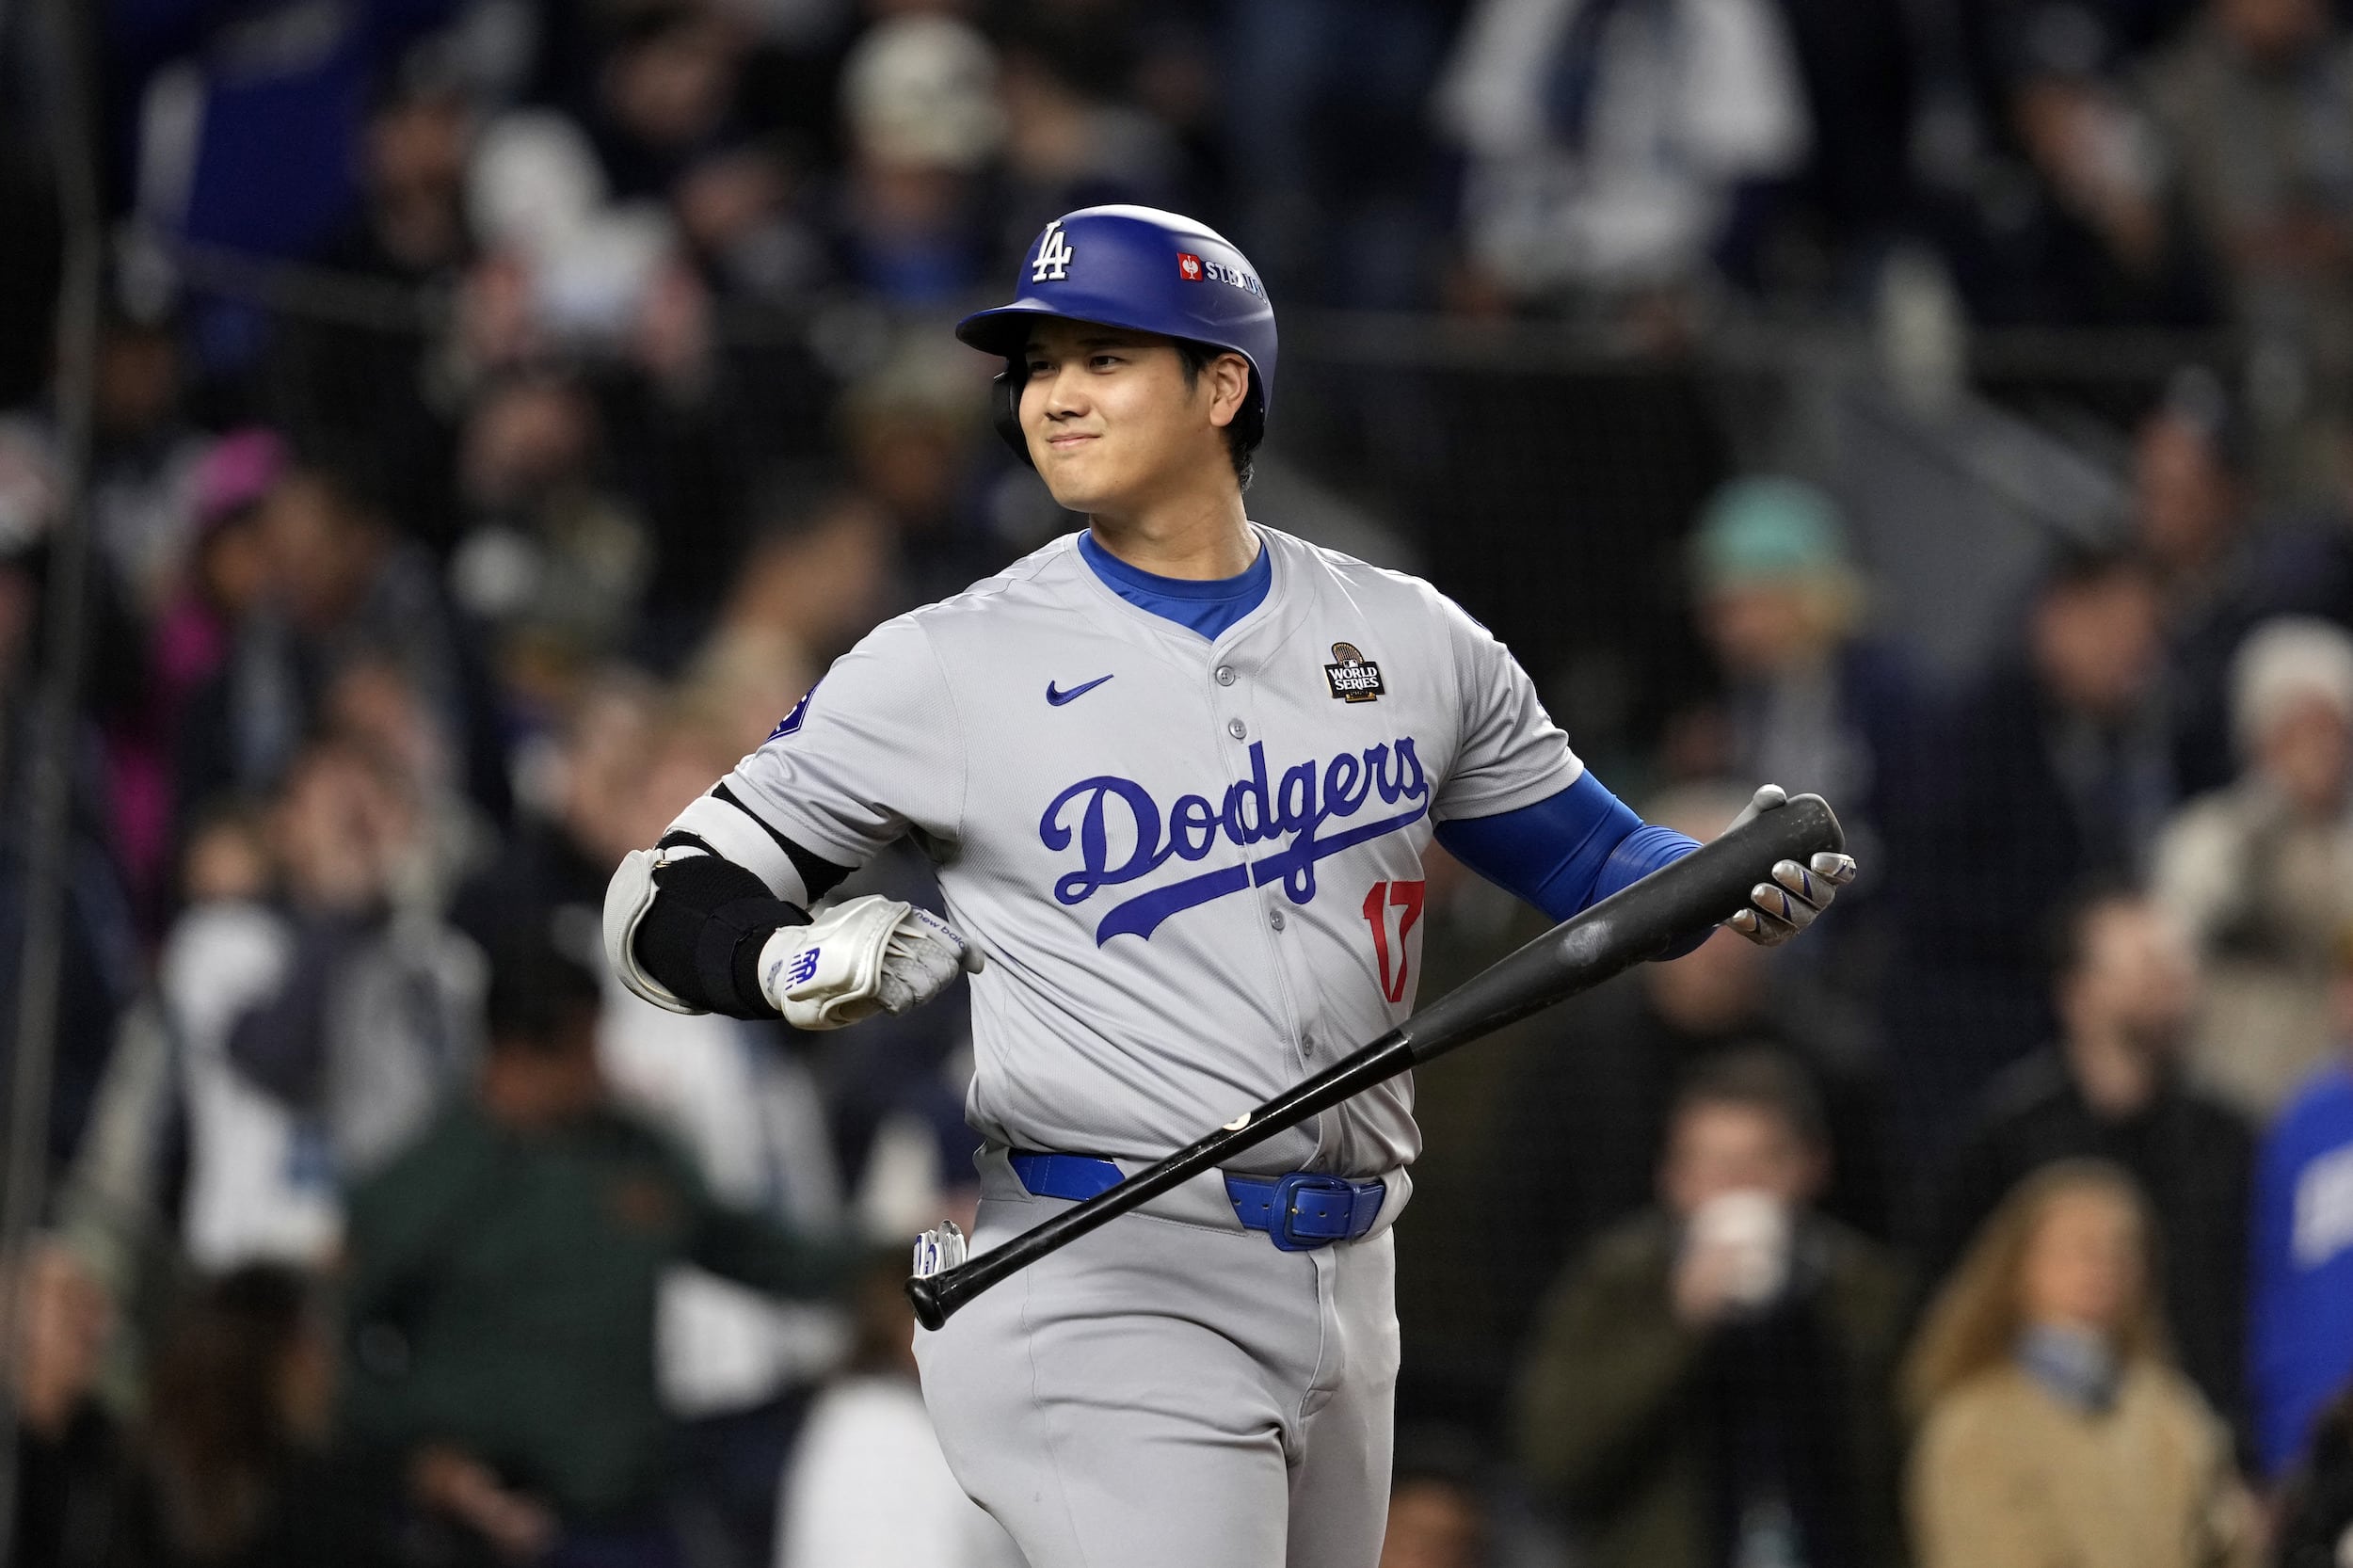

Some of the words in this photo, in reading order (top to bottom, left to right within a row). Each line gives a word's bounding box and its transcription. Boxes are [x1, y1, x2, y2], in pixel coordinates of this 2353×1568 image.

[1032, 219, 1074, 283] LA
[1205, 261, 1268, 305] STRAU
[1328, 666, 1378, 680] WORLD
[1335, 677, 1380, 690] SERIES
[1039, 736, 1429, 905] Dodgers
[914, 911, 939, 928] new
[1363, 880, 1425, 1003] 17
